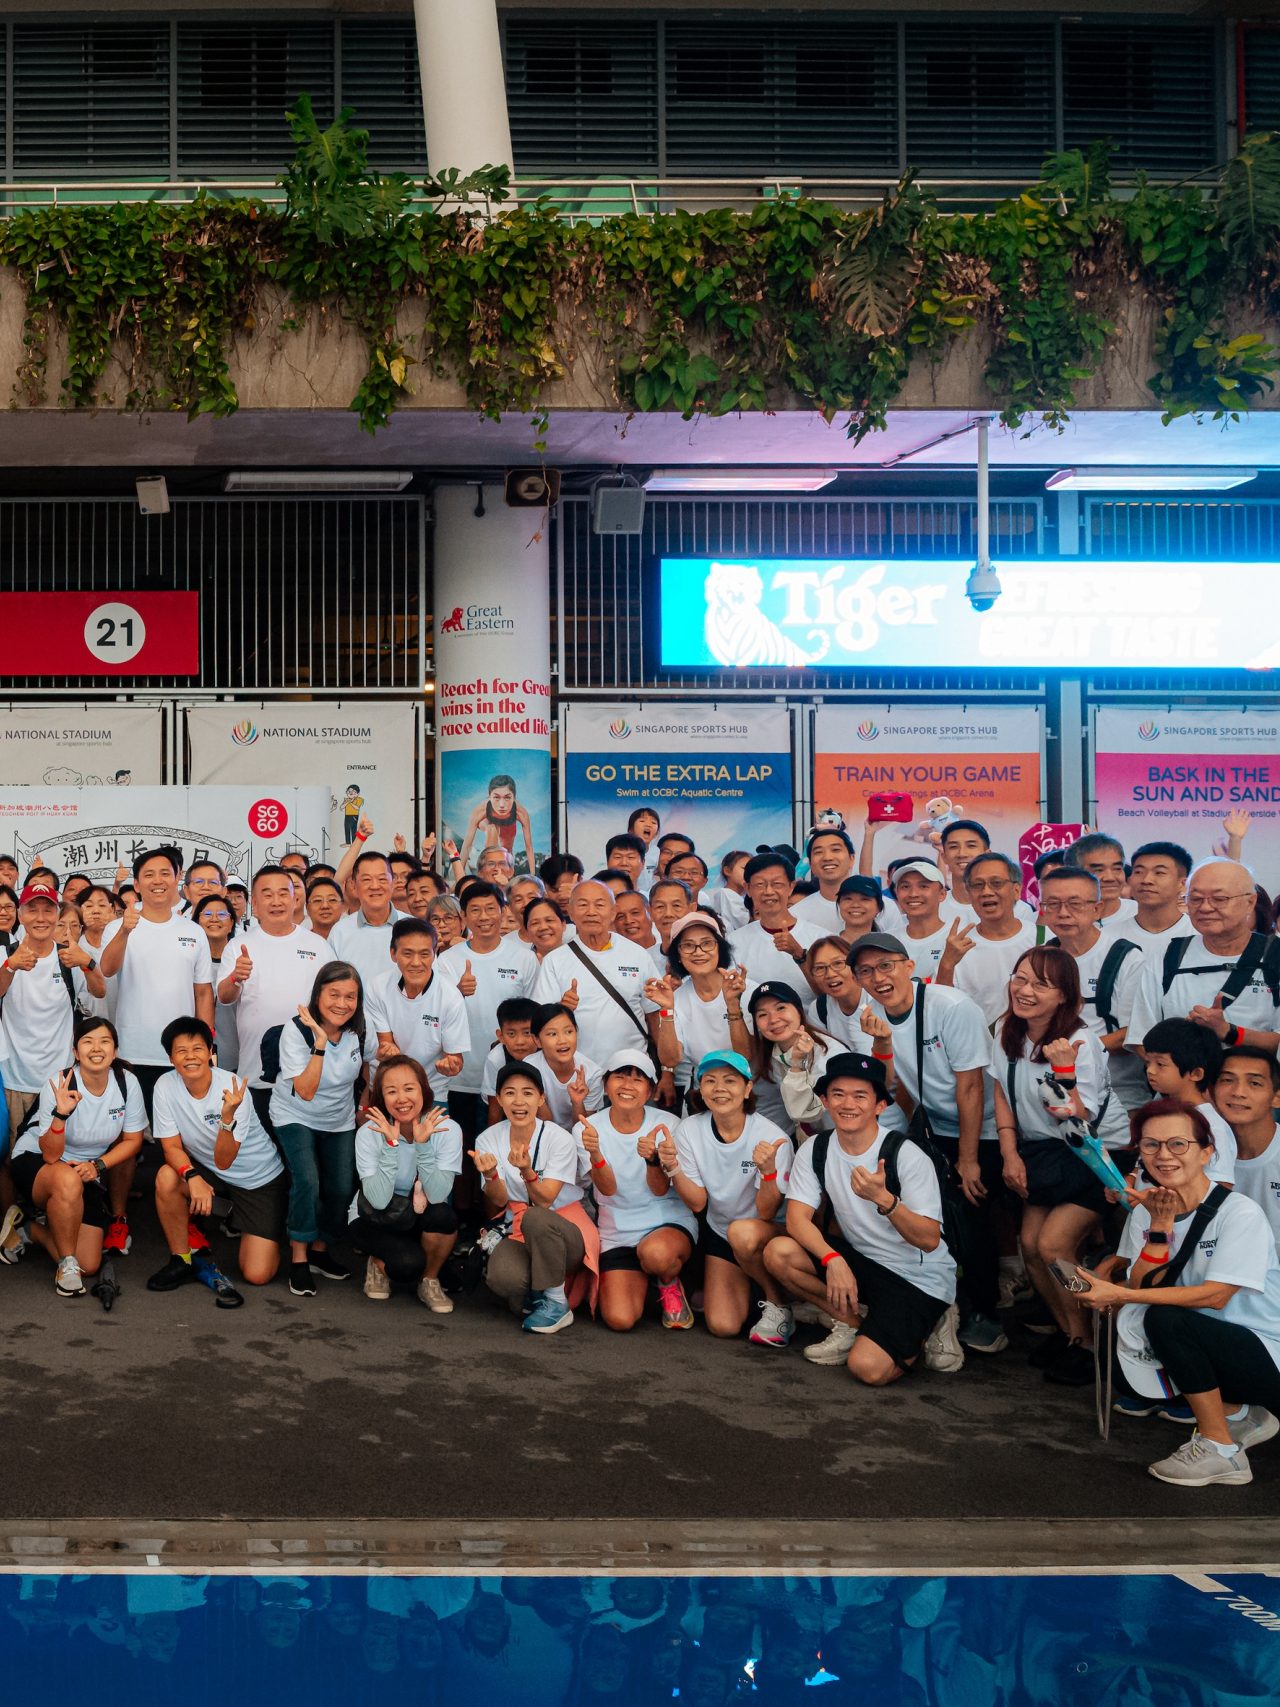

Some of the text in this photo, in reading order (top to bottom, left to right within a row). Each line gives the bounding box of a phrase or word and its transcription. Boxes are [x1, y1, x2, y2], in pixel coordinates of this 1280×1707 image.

[466, 604, 502, 618] Great
[771, 563, 949, 651] Tiger
[466, 618, 514, 631] Eastern
[96, 618, 134, 647] 21
[441, 677, 551, 698] Reach for Grea
[441, 698, 526, 717] wins in the
[263, 727, 371, 737] NATIONAL STADIUM
[441, 722, 473, 737] race
[476, 717, 530, 734] called
[635, 725, 748, 734] SINGAPORE SPORTS HUB
[883, 726, 998, 735] SINGAPORE SPORTS HUB
[1164, 727, 1277, 736] SINGAPORE SPORTS HUB
[5, 730, 112, 739] NATIONAL STADIUM
[586, 765, 773, 781] GO THE EXTRA LAP
[833, 766, 1021, 782] TRAIN YOUR GAME
[1148, 767, 1270, 782] BASK IN THE
[616, 788, 744, 798] Swim at OCBC Aquatic Centre
[941, 789, 966, 797] OCBC
[969, 789, 995, 797] Arena
[1133, 786, 1280, 802] SUN AND SAND
[257, 804, 279, 818] SG
[1118, 808, 1145, 817] Beach
[1148, 808, 1189, 818] Volleyball
[1191, 809, 1200, 817] at
[257, 818, 279, 832] 60
